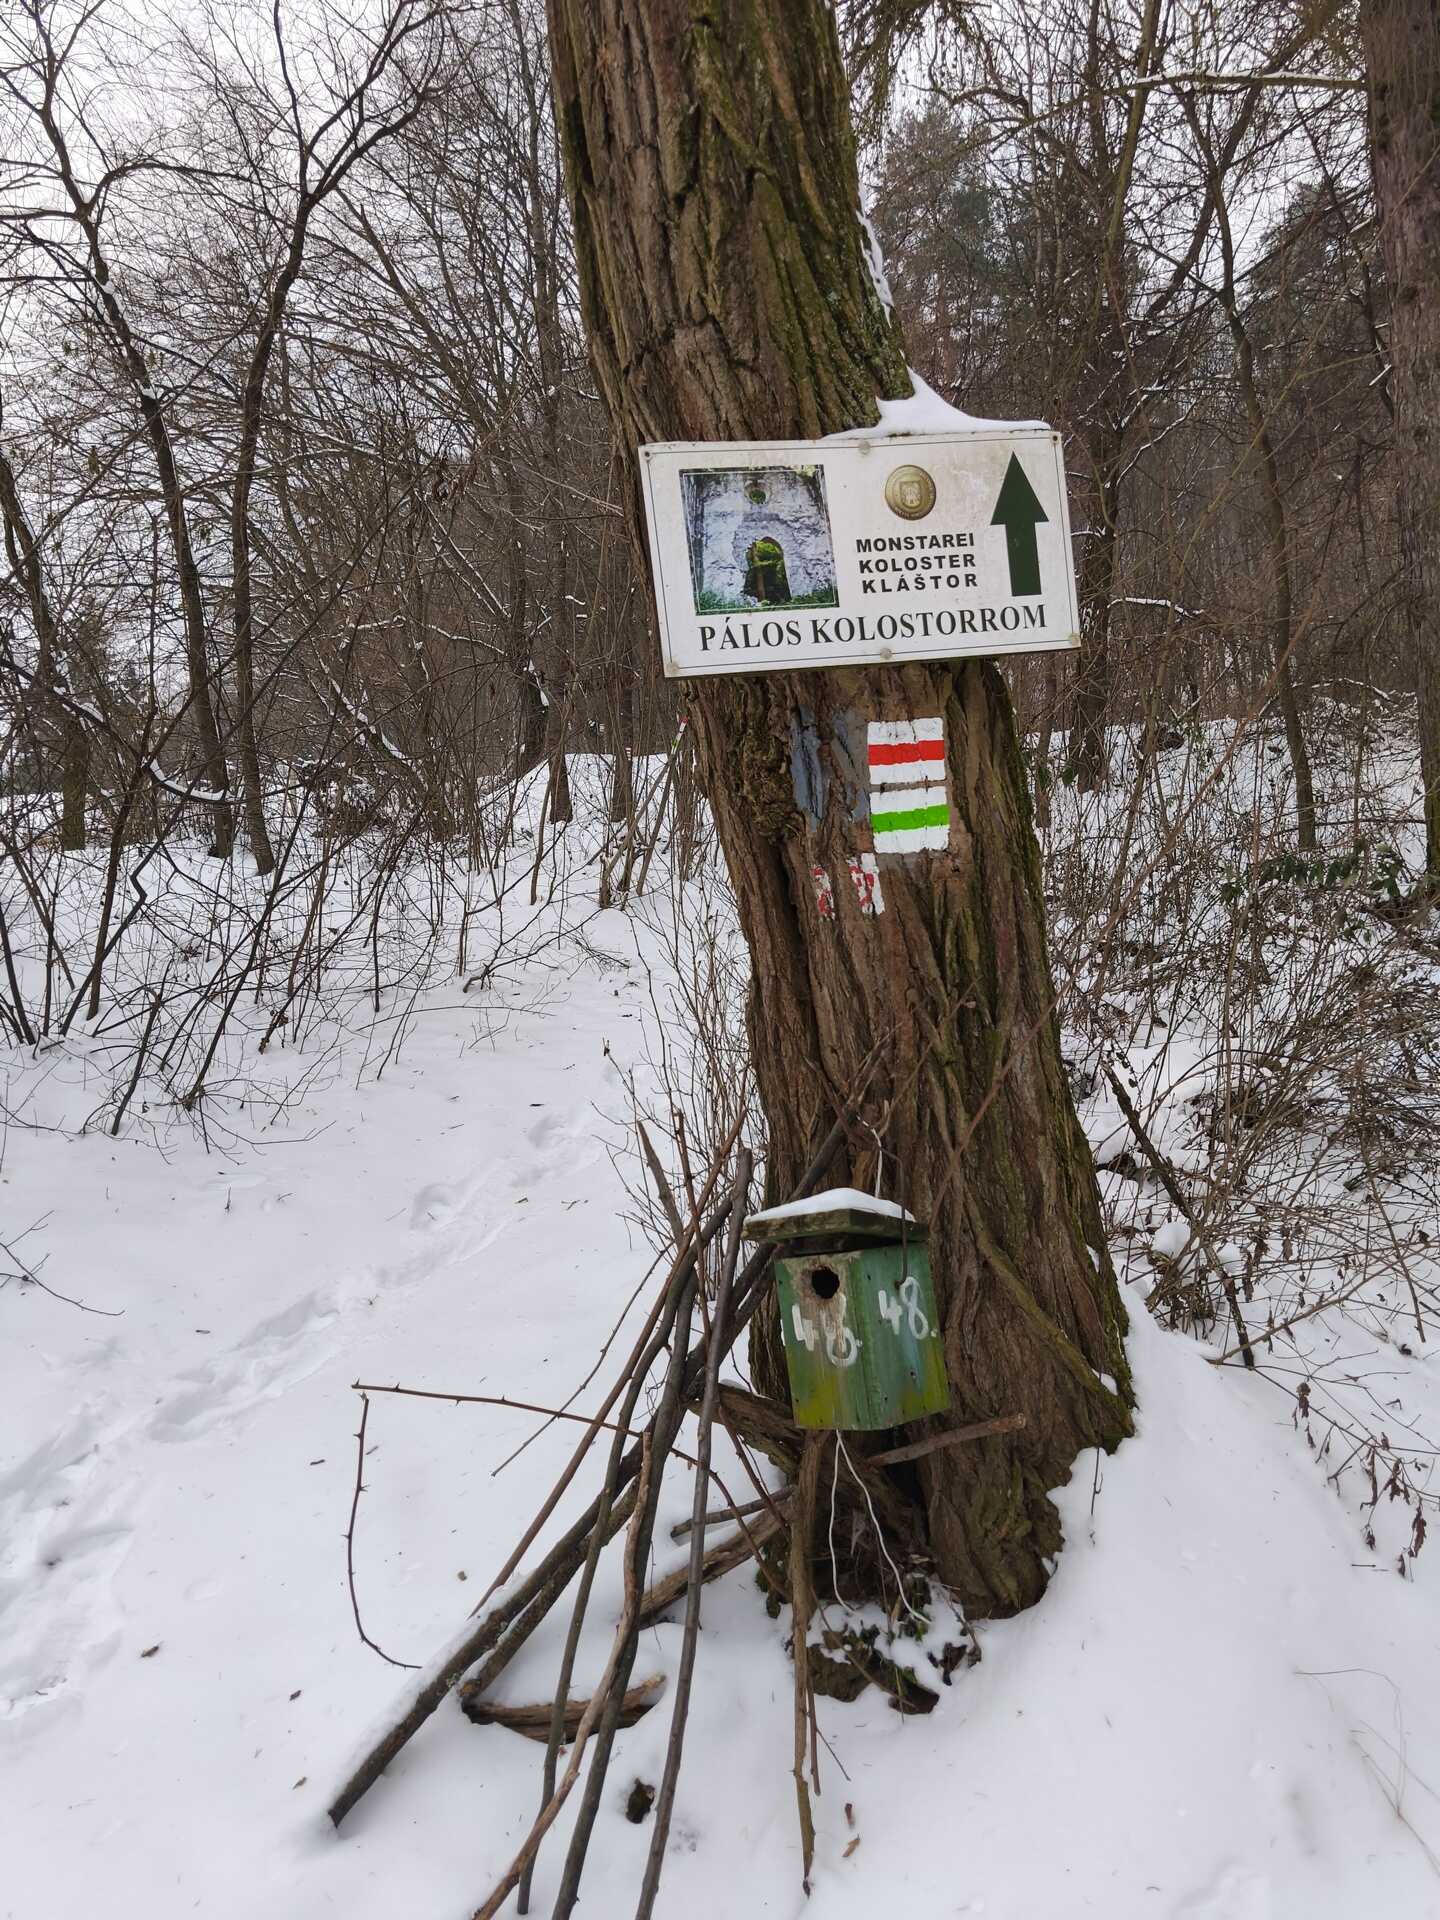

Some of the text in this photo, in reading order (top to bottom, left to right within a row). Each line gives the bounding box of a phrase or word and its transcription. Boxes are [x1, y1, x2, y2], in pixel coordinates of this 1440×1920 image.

[856, 533, 975, 553] MONSTAREI
[859, 554, 976, 574] KOLOSTER
[862, 574, 978, 594] KLÁŠTOR
[698, 604, 1048, 651] PÁLOS KOLOSTORROM
